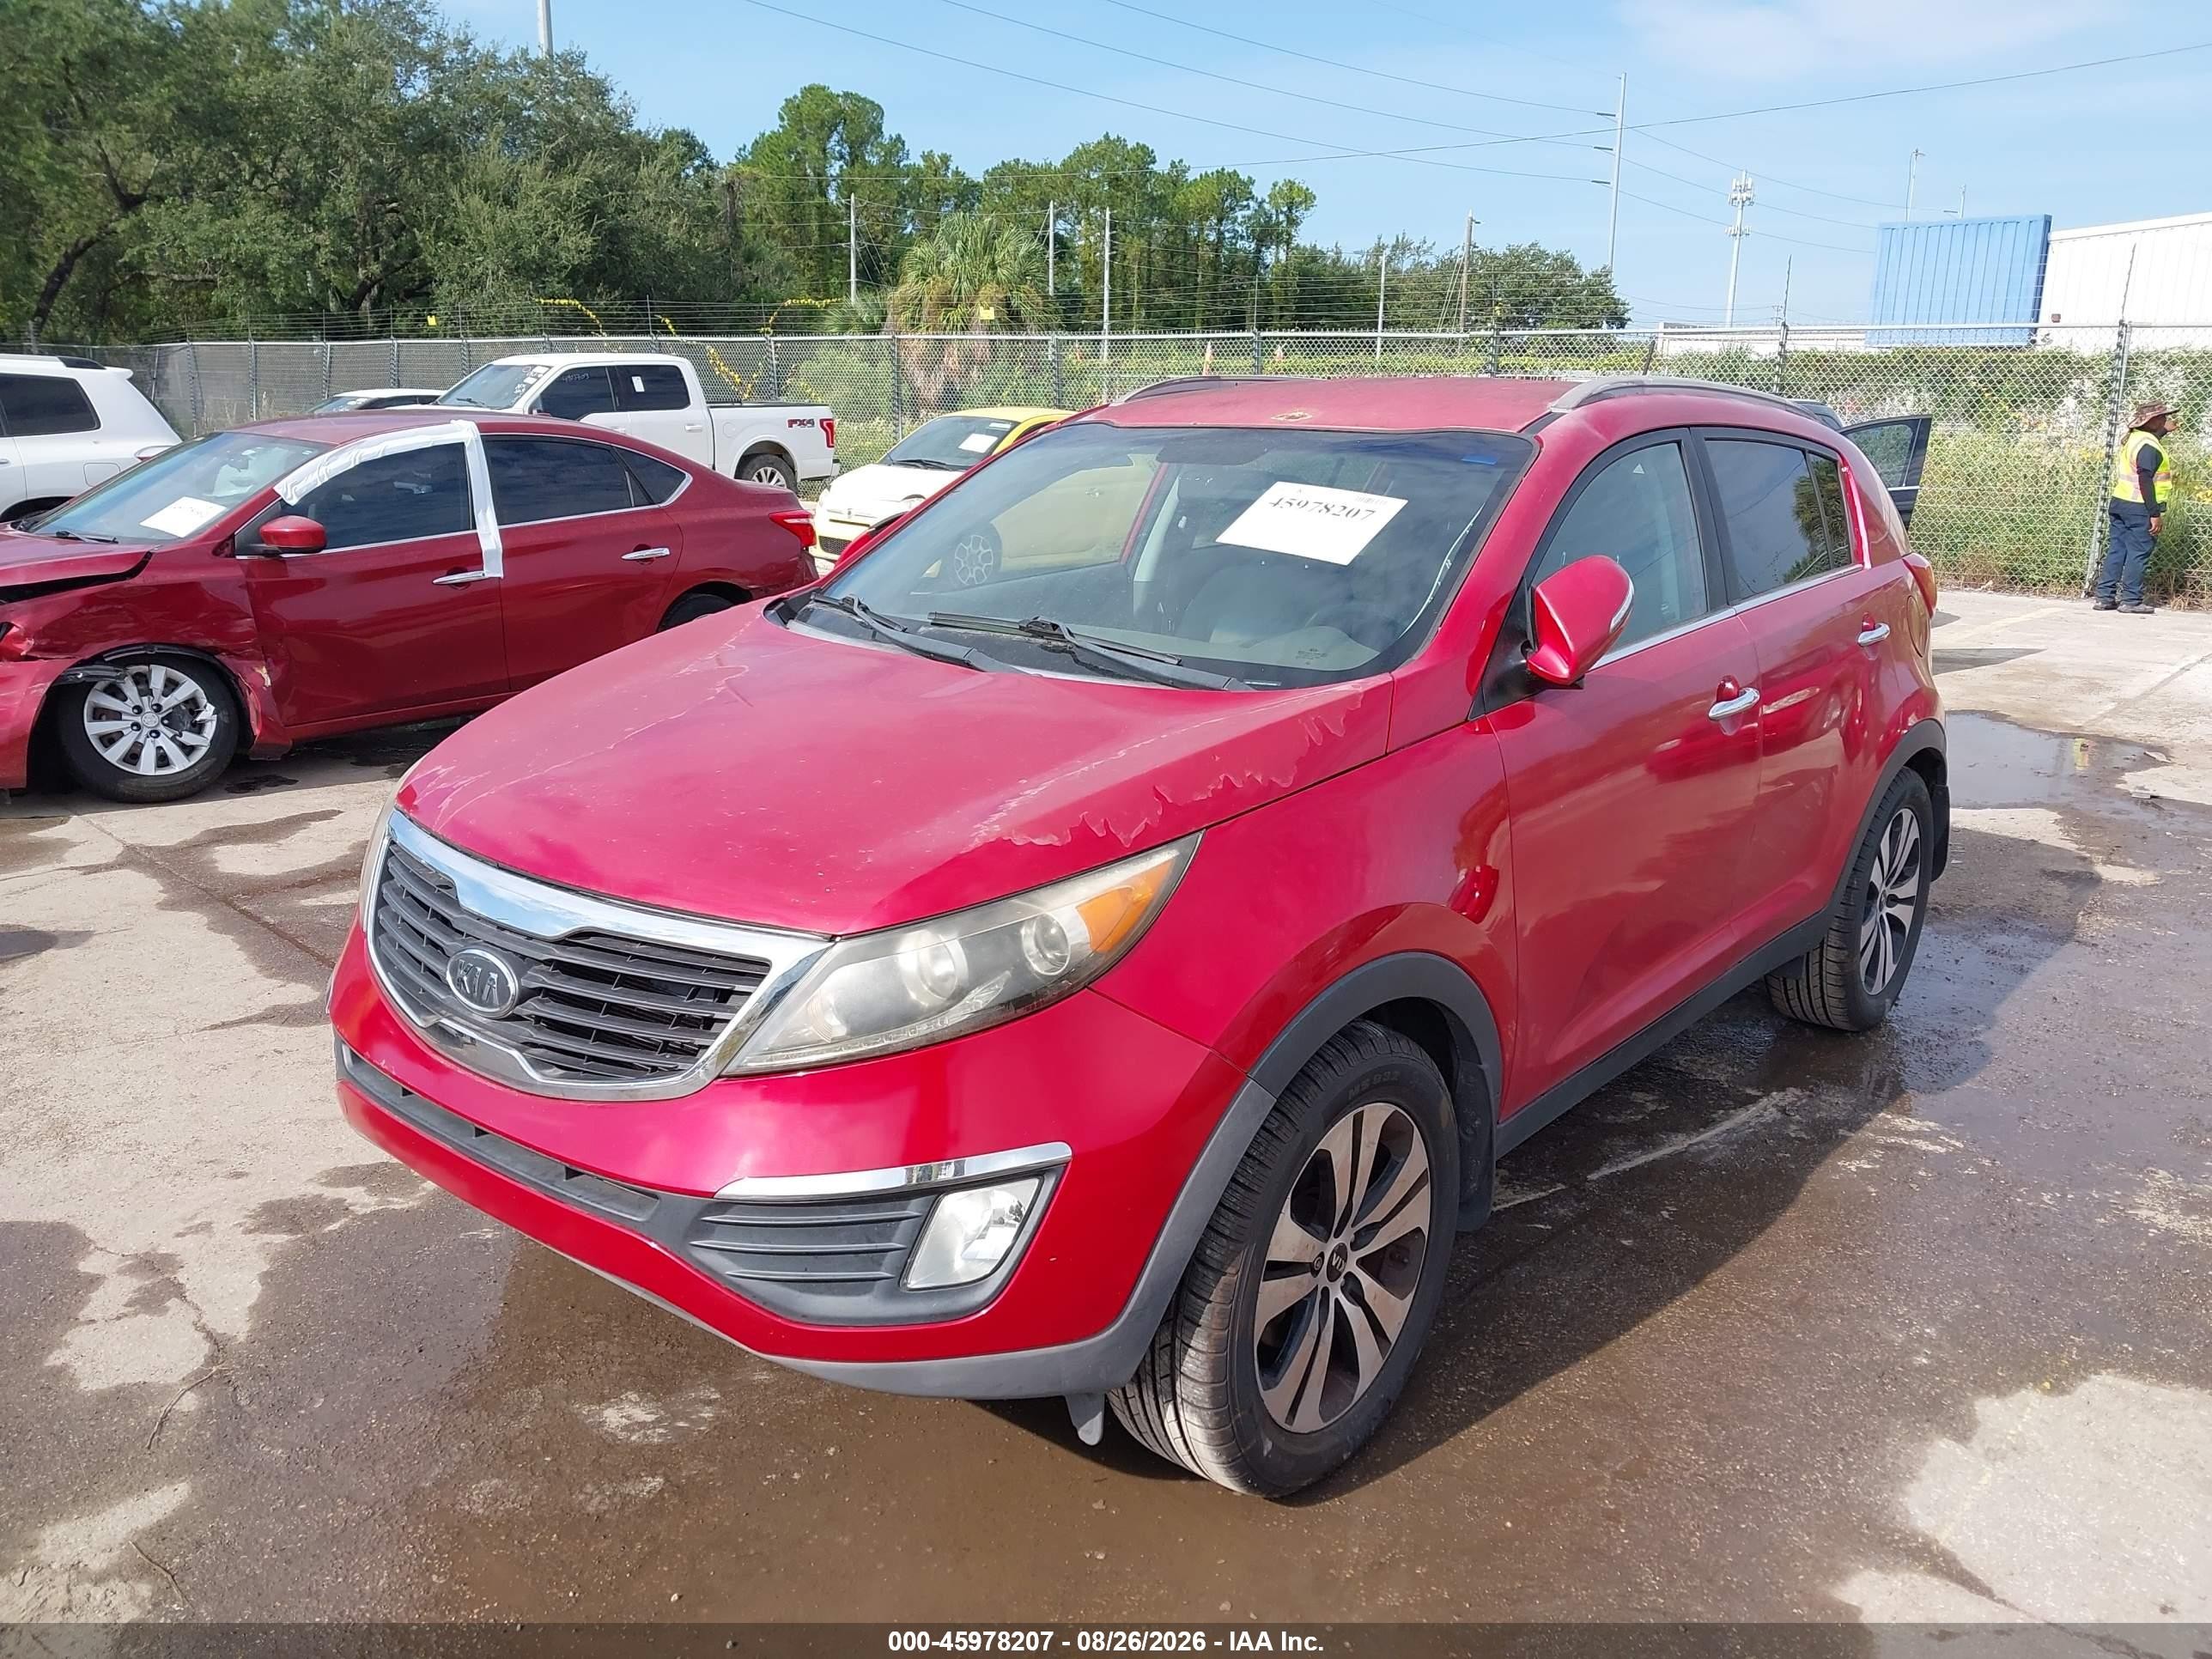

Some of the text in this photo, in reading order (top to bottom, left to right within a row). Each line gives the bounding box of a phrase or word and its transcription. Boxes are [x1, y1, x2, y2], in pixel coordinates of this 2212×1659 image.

[787, 418, 815, 428] FX4
[1268, 496, 1377, 521] 45978207
[455, 958, 500, 1006] KIA
